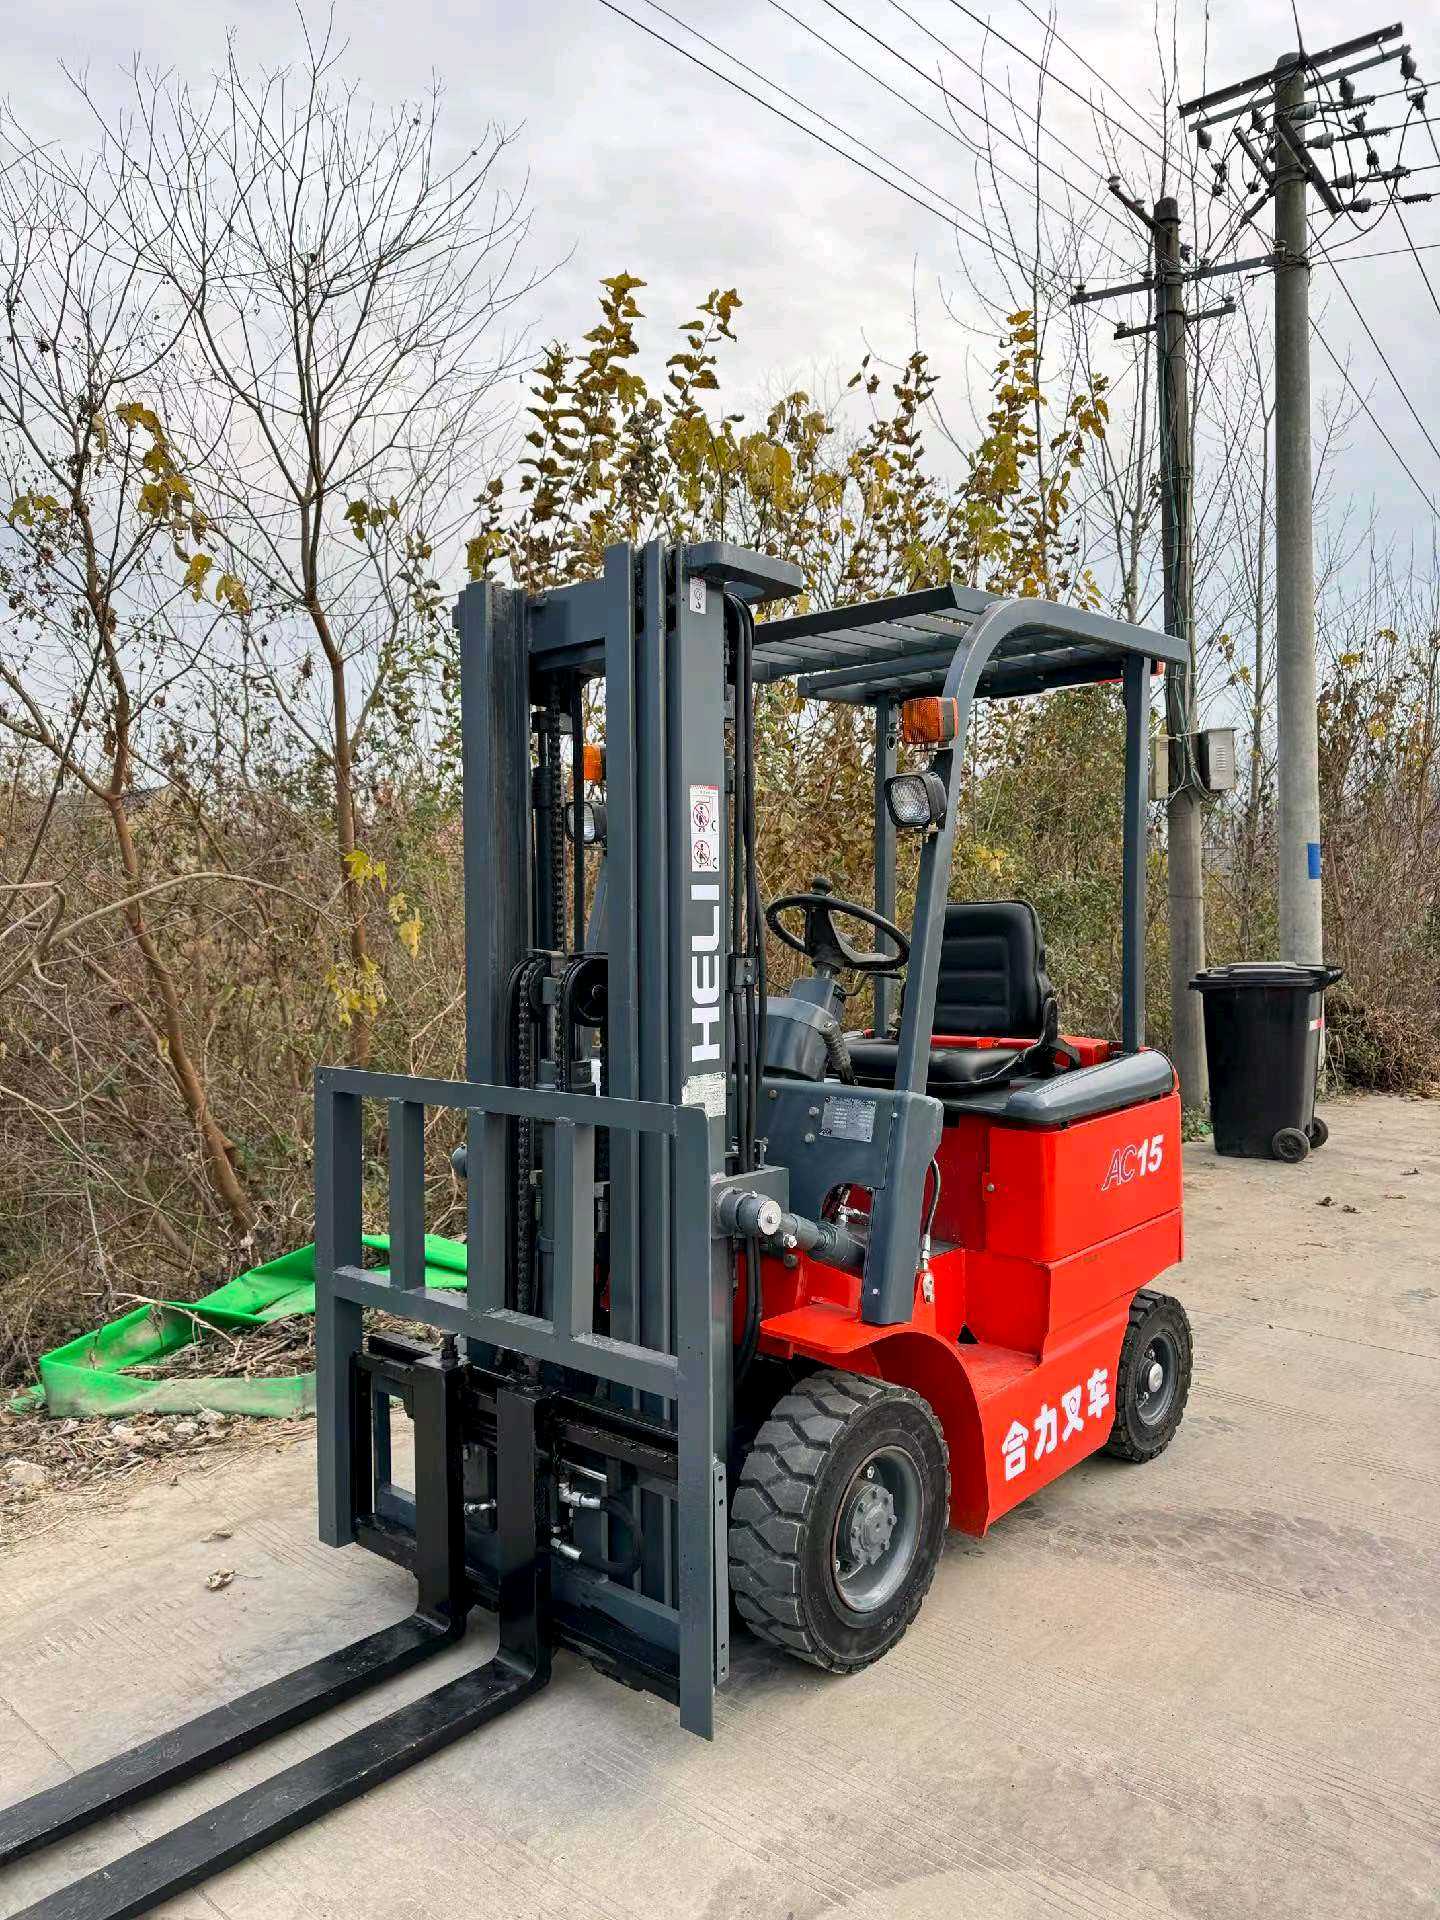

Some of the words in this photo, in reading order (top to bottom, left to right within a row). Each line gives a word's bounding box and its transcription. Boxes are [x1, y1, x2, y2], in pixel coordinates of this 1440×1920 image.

[691, 884, 720, 1062] HELI
[1101, 1134, 1164, 1191] AC15
[1001, 1368, 1110, 1481] 合力叉车
